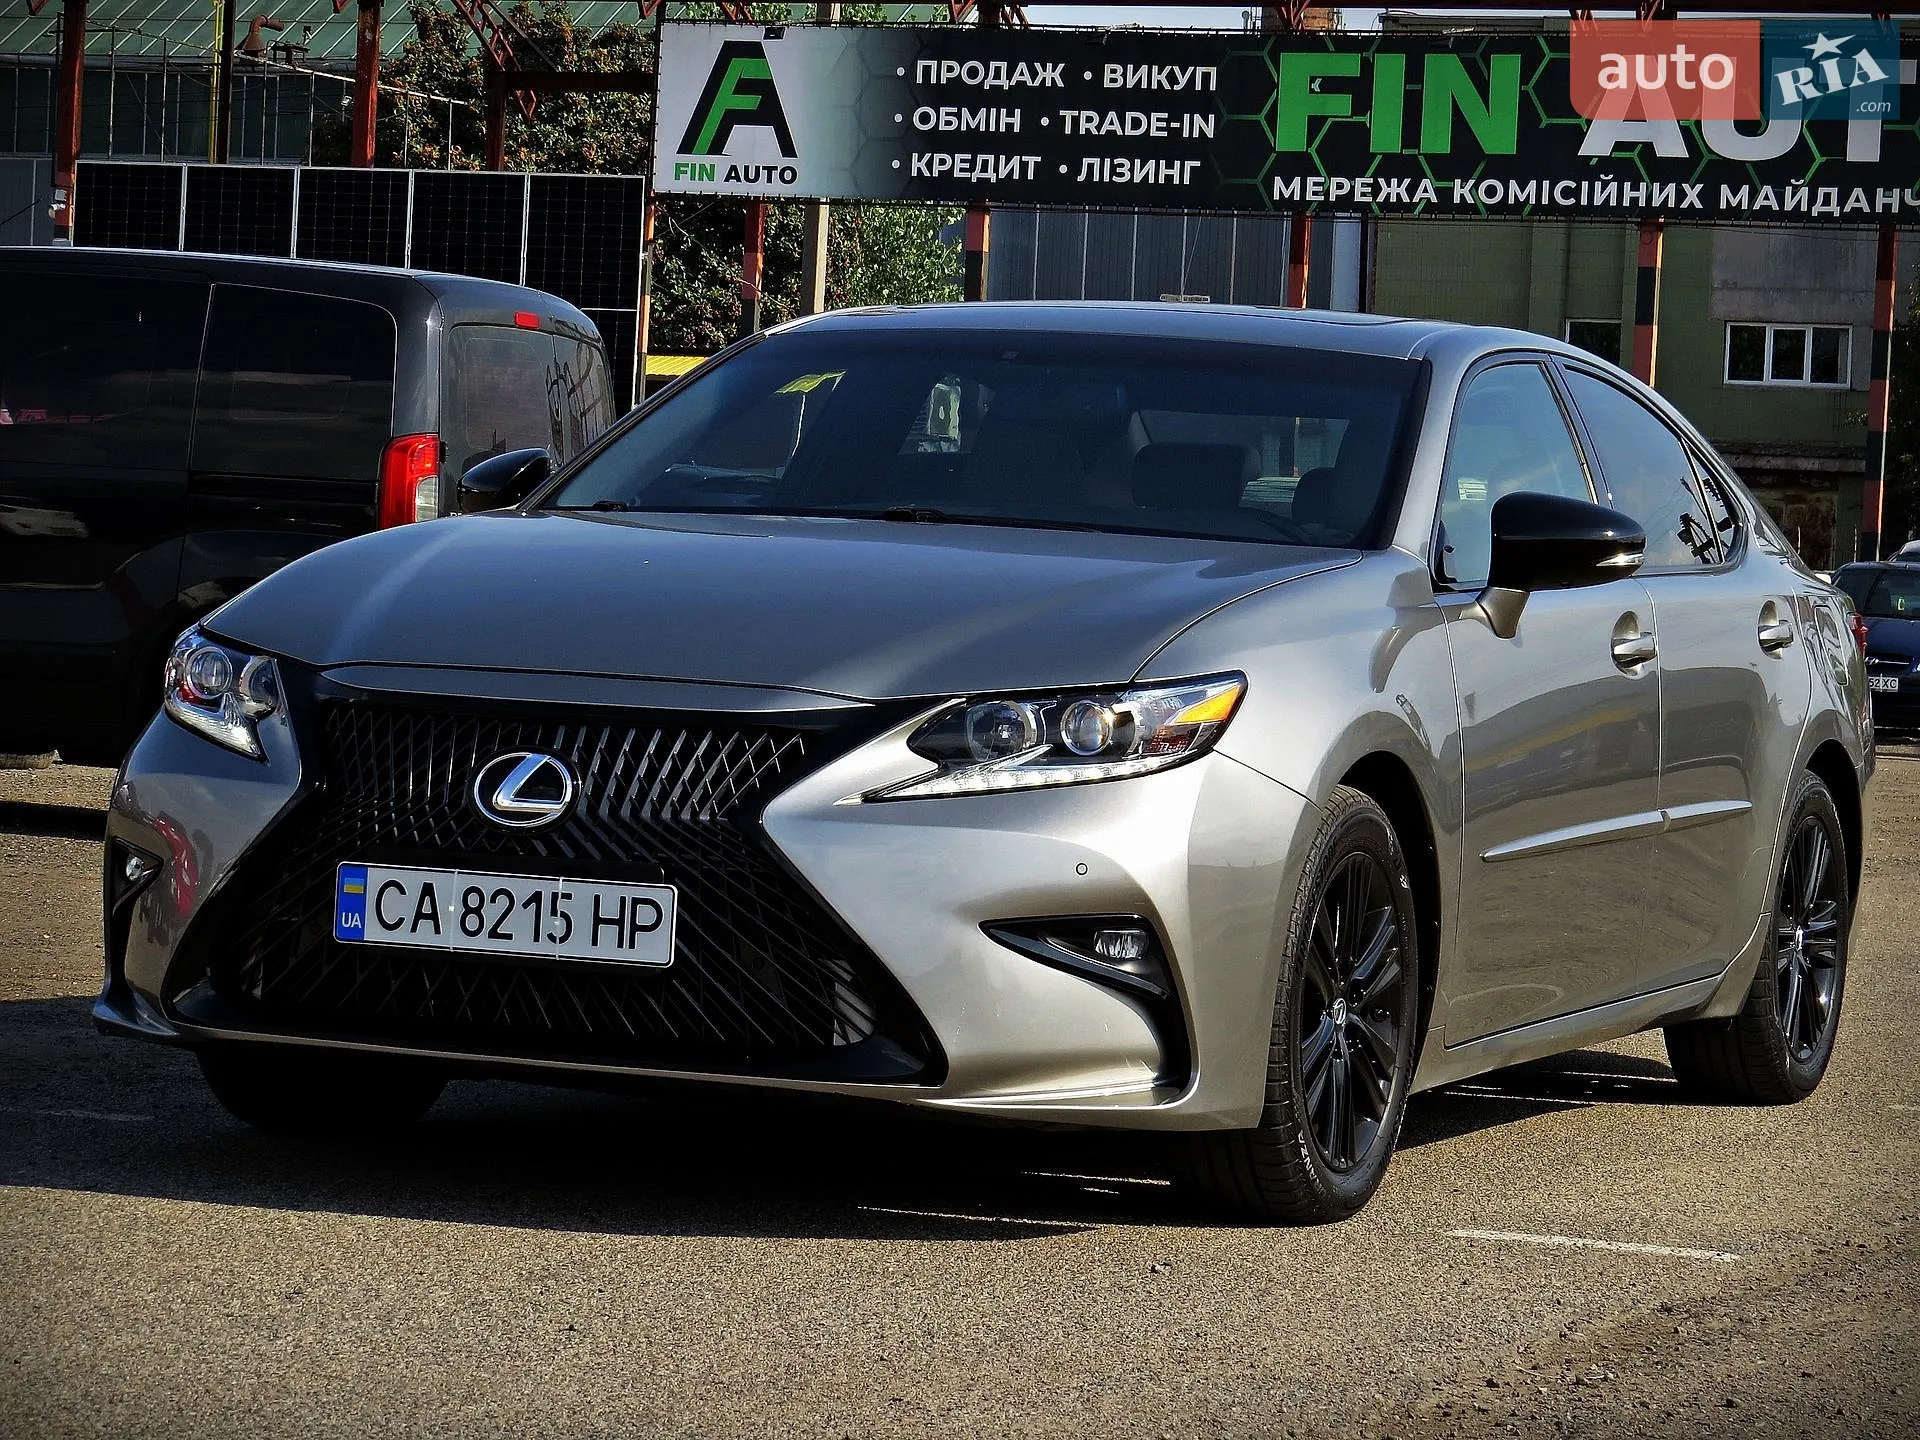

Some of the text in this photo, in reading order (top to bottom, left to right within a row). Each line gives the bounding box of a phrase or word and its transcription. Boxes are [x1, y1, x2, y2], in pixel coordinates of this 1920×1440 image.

[916, 60, 1065, 90] ПРОДАЖ
[1104, 64, 1217, 92] ВИКУП
[1275, 53, 1521, 154] FIN
[913, 106, 1021, 133] ОБМІН
[1060, 110, 1215, 138] TRADE-IN
[674, 162, 798, 184] FIN AUTO
[911, 153, 1042, 182] КРЕДИТ
[1077, 157, 1201, 185] ЛІЗИНГ
[1273, 176, 1438, 203] МЕРЕЖА
[1453, 174, 1703, 209] КОМІСІЙНИХ
[341, 912, 362, 929] UA
[375, 880, 665, 949] CA 8215 HP
